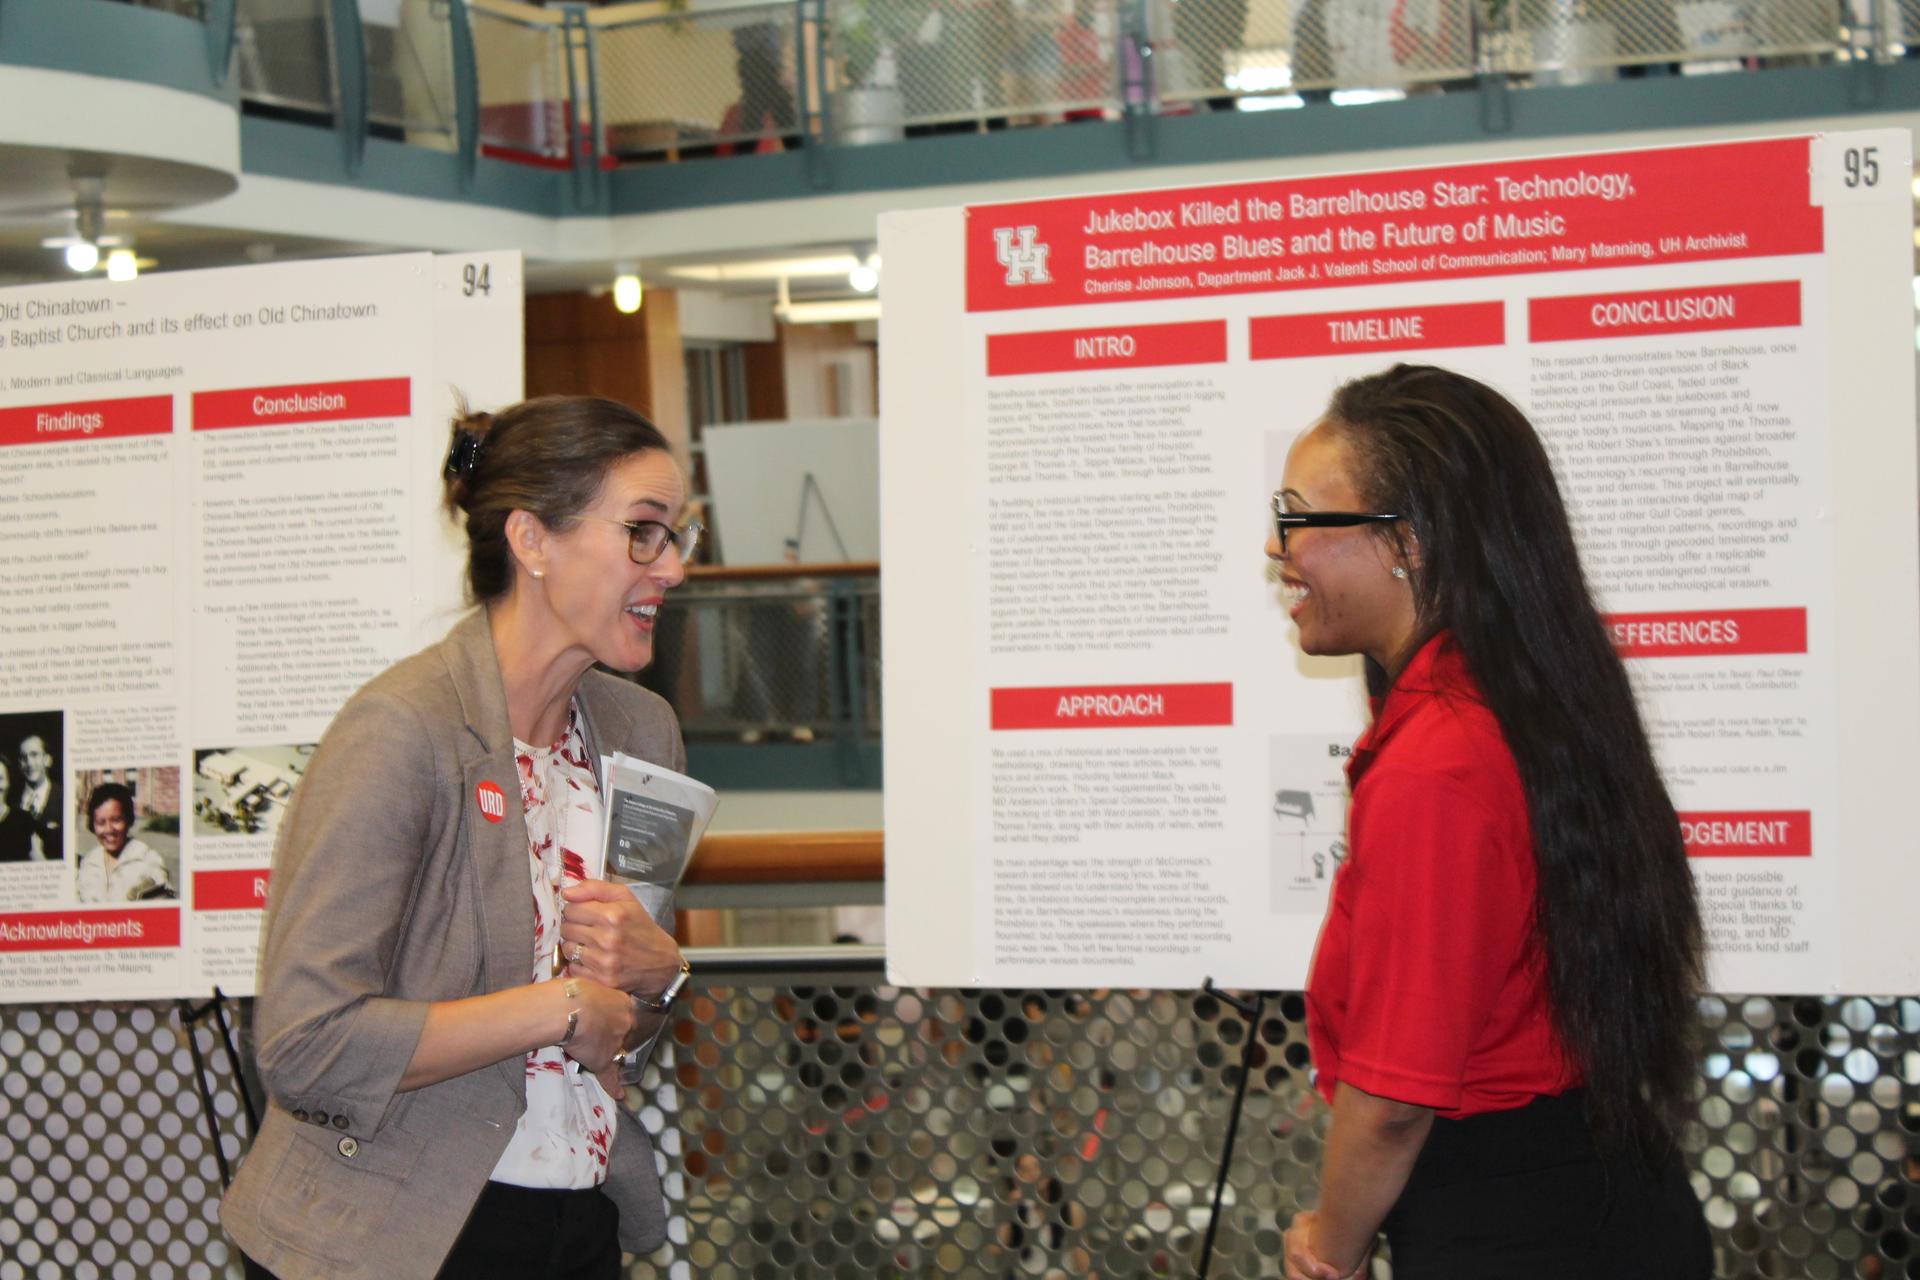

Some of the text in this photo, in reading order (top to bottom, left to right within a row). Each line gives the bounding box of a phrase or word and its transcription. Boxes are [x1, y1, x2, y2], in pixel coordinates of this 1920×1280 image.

[1843, 147, 1879, 188] 95
[1084, 171, 1635, 235] Jukebox Killed the Barrelhouse Star: Technology,
[1084, 211, 1566, 270] Barrelhouse Blues and the Future of Music
[993, 225, 1052, 286] UH
[1084, 277, 1131, 295] Cherise
[1136, 272, 1193, 291] Johnson,
[1198, 267, 1272, 287] Department
[1276, 264, 1305, 281] Jack
[1324, 260, 1368, 278] Valenti
[1373, 255, 1417, 274] School
[1421, 254, 1435, 270] of
[1439, 248, 1547, 270] Communication;
[1552, 245, 1587, 264] Mary
[1591, 239, 1654, 258] Manning,
[1660, 236, 1681, 253] UH
[1686, 232, 1747, 250] Archivist
[462, 264, 491, 297] 94
[25, 297, 111, 319] Chinatown
[1591, 295, 1735, 326] CONCLUSION
[10, 301, 376, 348] Baptist Church and its effect on Old Chinatown
[1328, 316, 1424, 344] TIMELINE
[1074, 336, 1135, 359] INTRO
[10, 365, 184, 390] Modern and Classical Languages
[252, 391, 347, 416] Conclusion
[37, 410, 103, 434] Findings
[1056, 693, 1164, 718] APPROACH
[479, 788, 503, 817] URD
[0, 918, 144, 943] Acknowledgments
